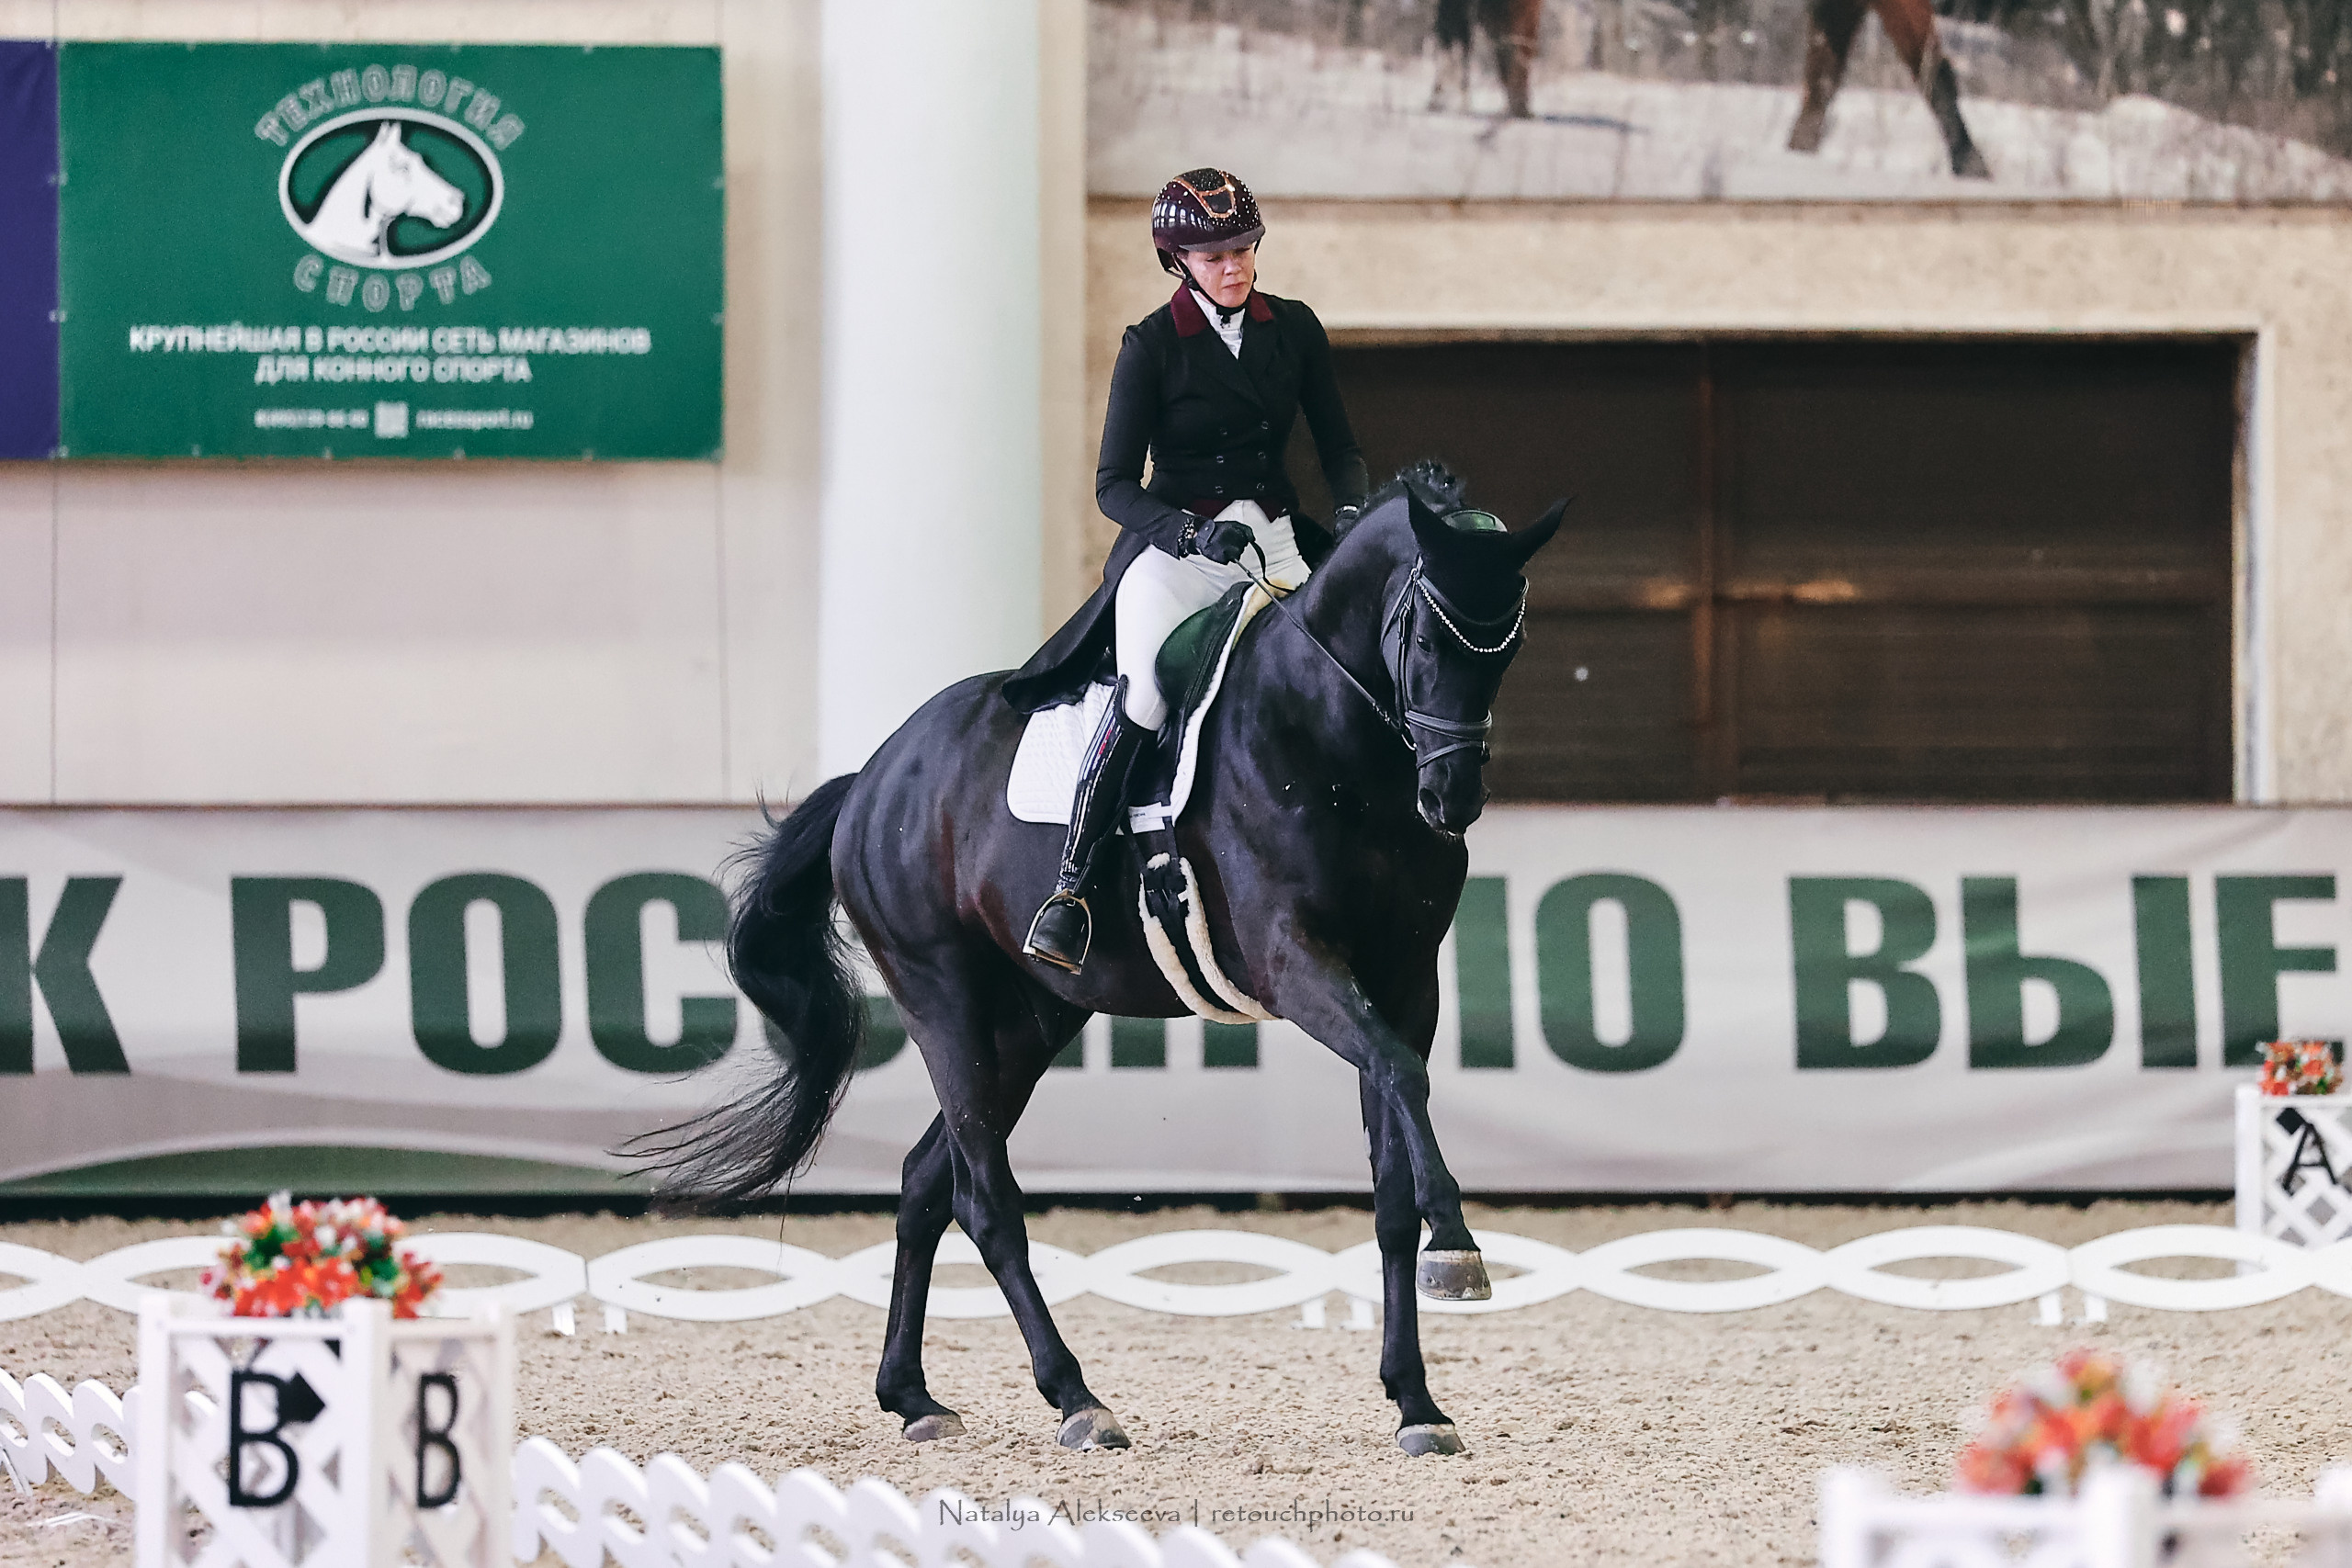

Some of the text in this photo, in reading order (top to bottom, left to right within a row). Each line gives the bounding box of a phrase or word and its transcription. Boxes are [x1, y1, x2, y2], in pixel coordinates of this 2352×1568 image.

[254, 63, 525, 151] ТЕХНОЛОГИЯ
[293, 254, 492, 312] СПОРТА
[129, 321, 651, 355] КРУПНЕЙШАЯ В РОССИИ СЕТЬ МАГАЗИНОВ
[254, 355, 533, 386] ДЛЯ КОННОГО СПОРТА
[1787, 874, 2345, 1070] ВЫЕ
[2282, 1122, 2338, 1196] A
[229, 1370, 300, 1506] B
[416, 1372, 460, 1508] B
